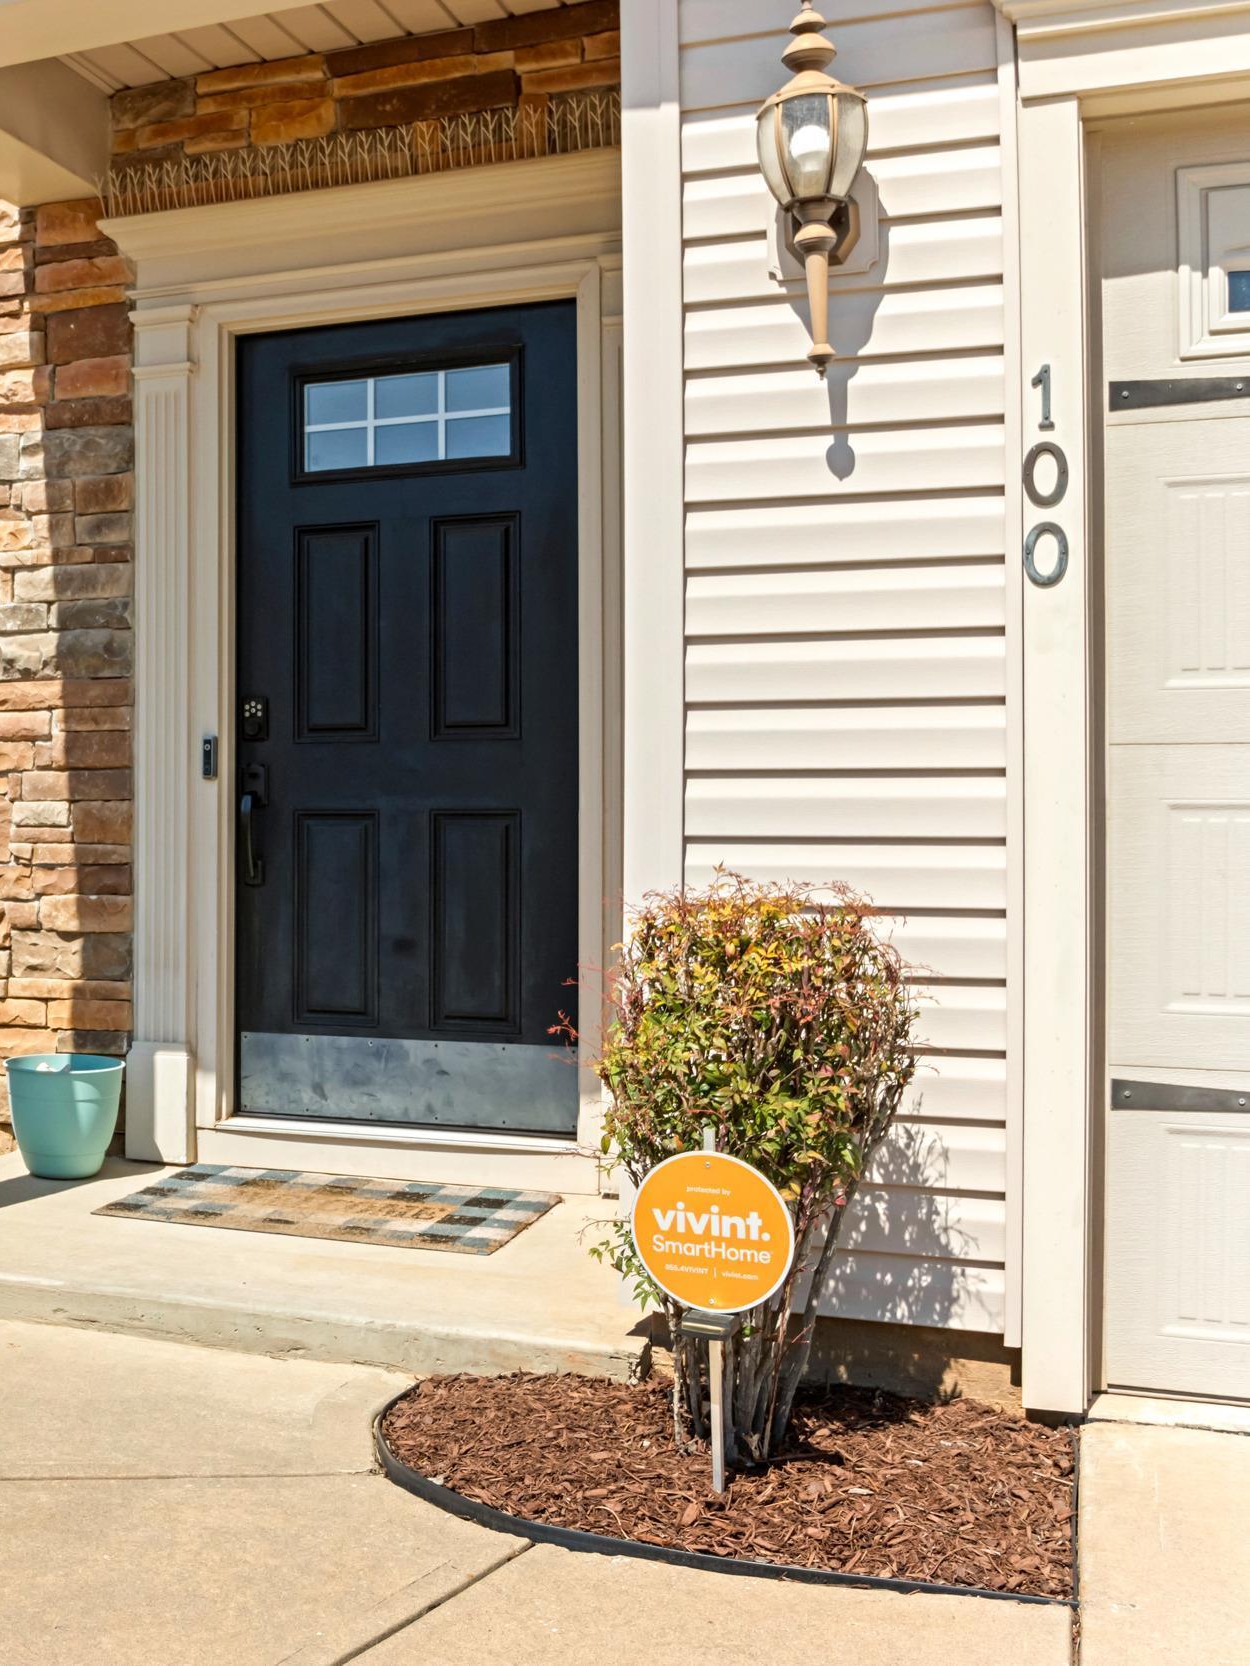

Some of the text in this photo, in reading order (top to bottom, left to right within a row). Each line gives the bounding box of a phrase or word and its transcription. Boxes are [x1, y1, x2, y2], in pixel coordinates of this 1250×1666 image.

[1023, 364, 1069, 589] 100
[652, 1201, 771, 1242] vivint.
[652, 1234, 771, 1264] SmartHome
